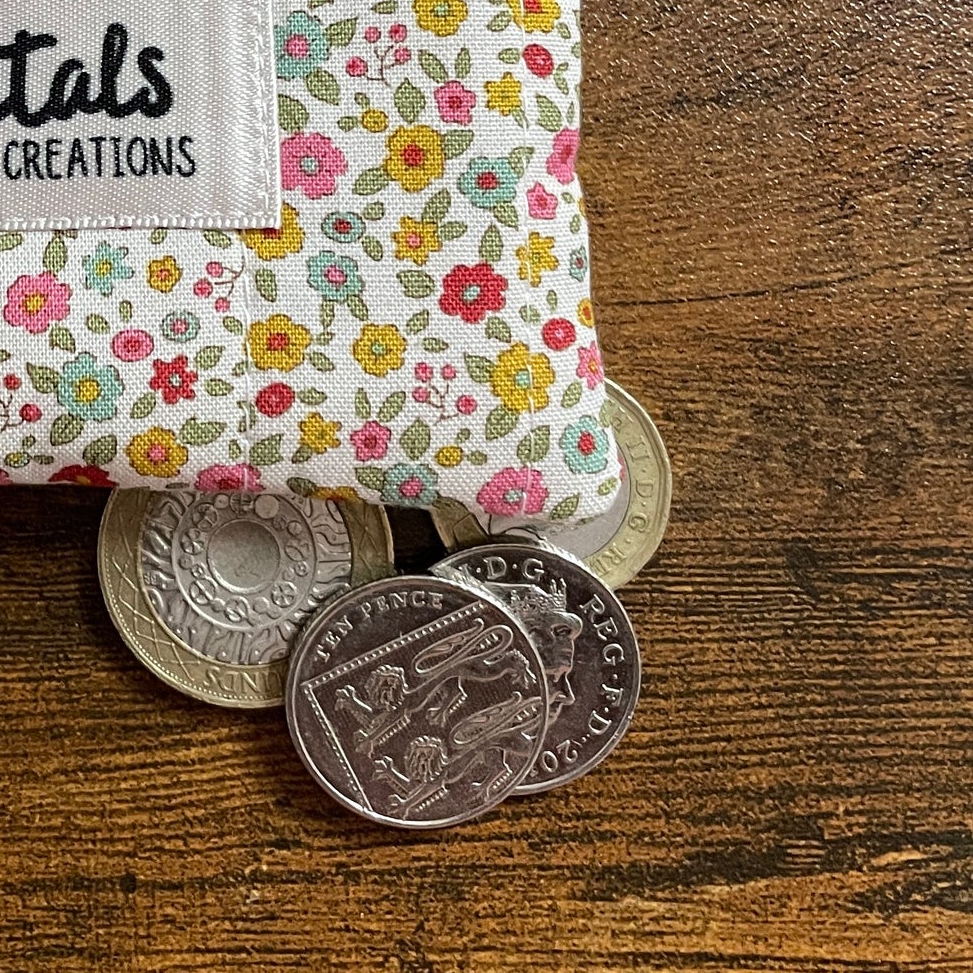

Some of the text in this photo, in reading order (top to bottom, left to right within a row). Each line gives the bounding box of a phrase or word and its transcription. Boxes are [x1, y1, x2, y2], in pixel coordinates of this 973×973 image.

[3, 136, 196, 180] CREATIONS
[315, 590, 445, 662] TEN PENCE
[203, 665, 282, 694] UNDS
